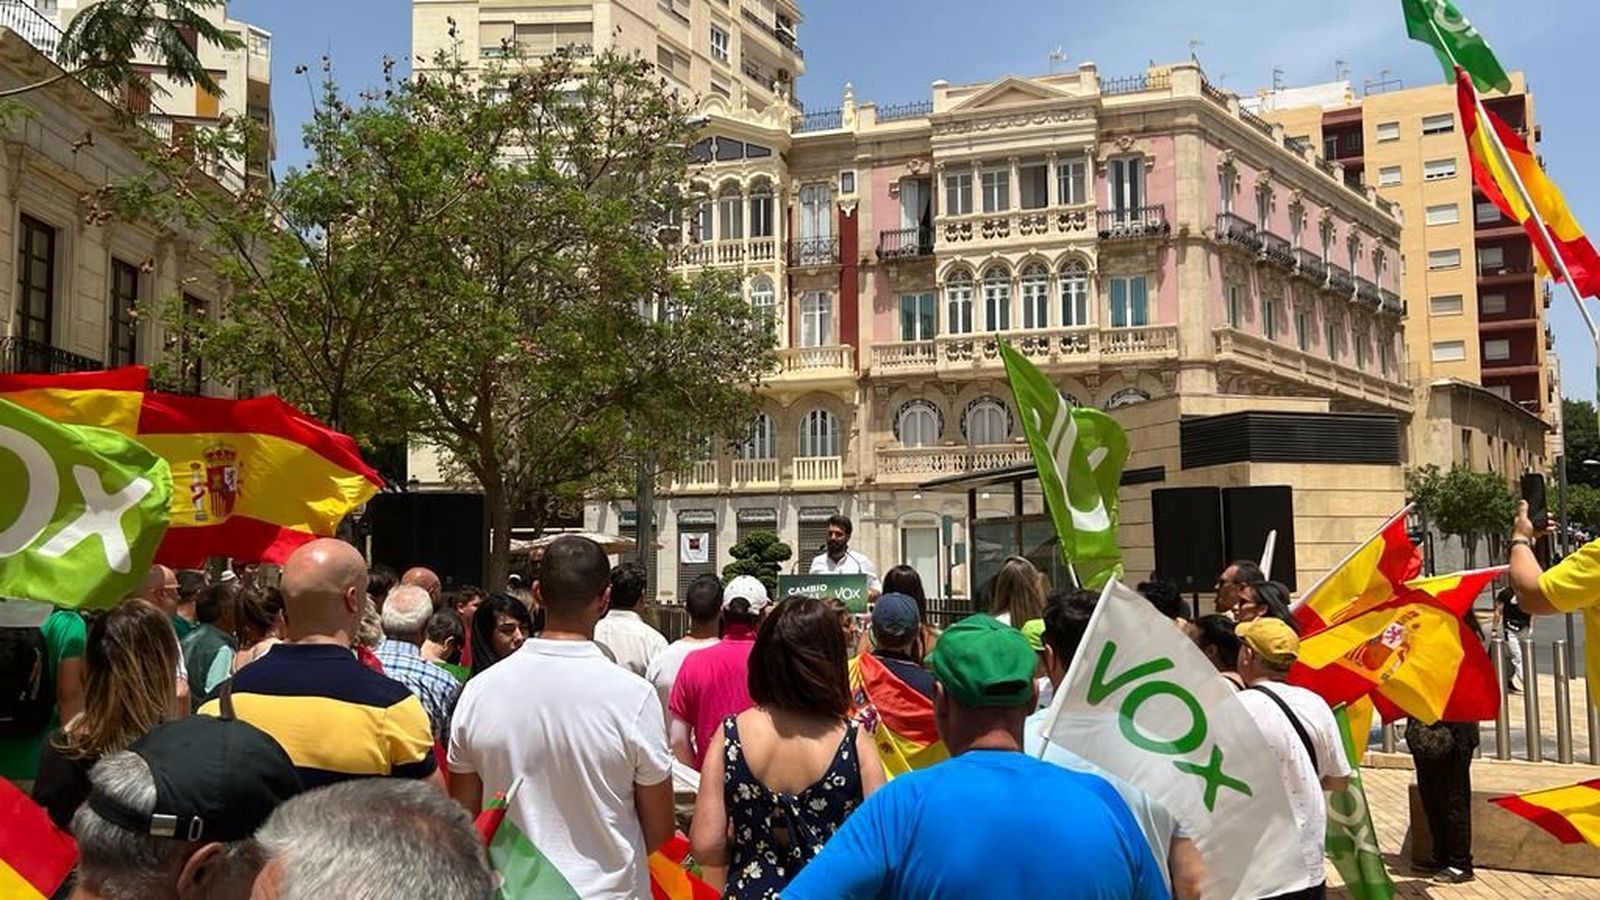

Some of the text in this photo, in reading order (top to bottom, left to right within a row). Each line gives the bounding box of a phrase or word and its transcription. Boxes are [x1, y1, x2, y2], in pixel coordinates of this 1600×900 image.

[787, 584, 828, 596] CAMBIO
[835, 587, 861, 600] VOX
[1086, 640, 1252, 813] VOX
